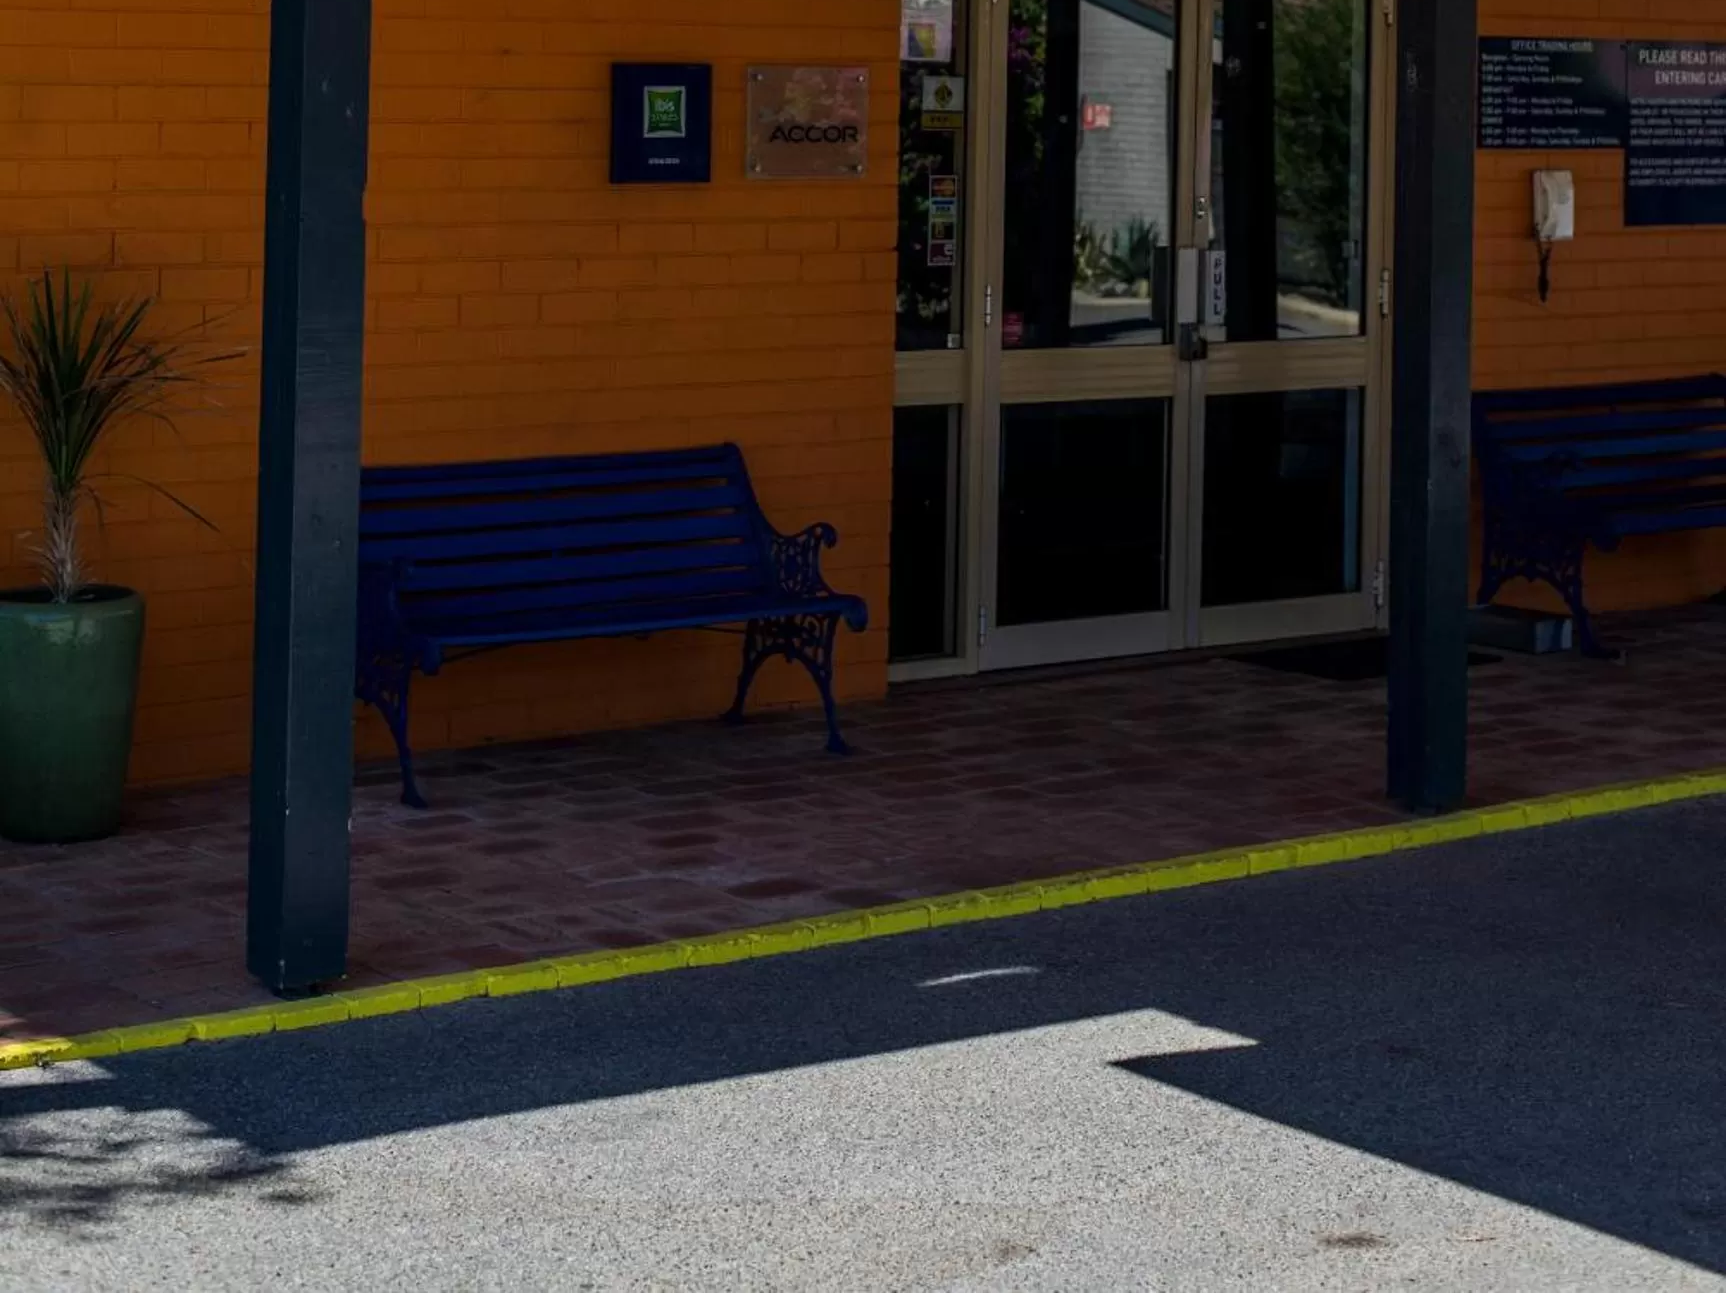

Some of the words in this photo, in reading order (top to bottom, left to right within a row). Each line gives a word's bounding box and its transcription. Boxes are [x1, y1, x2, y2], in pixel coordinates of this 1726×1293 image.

[1640, 49, 1677, 64] PLEASE
[1681, 50, 1708, 65] READ
[1655, 70, 1706, 85] ENTERING
[770, 125, 859, 144] ACCOR
